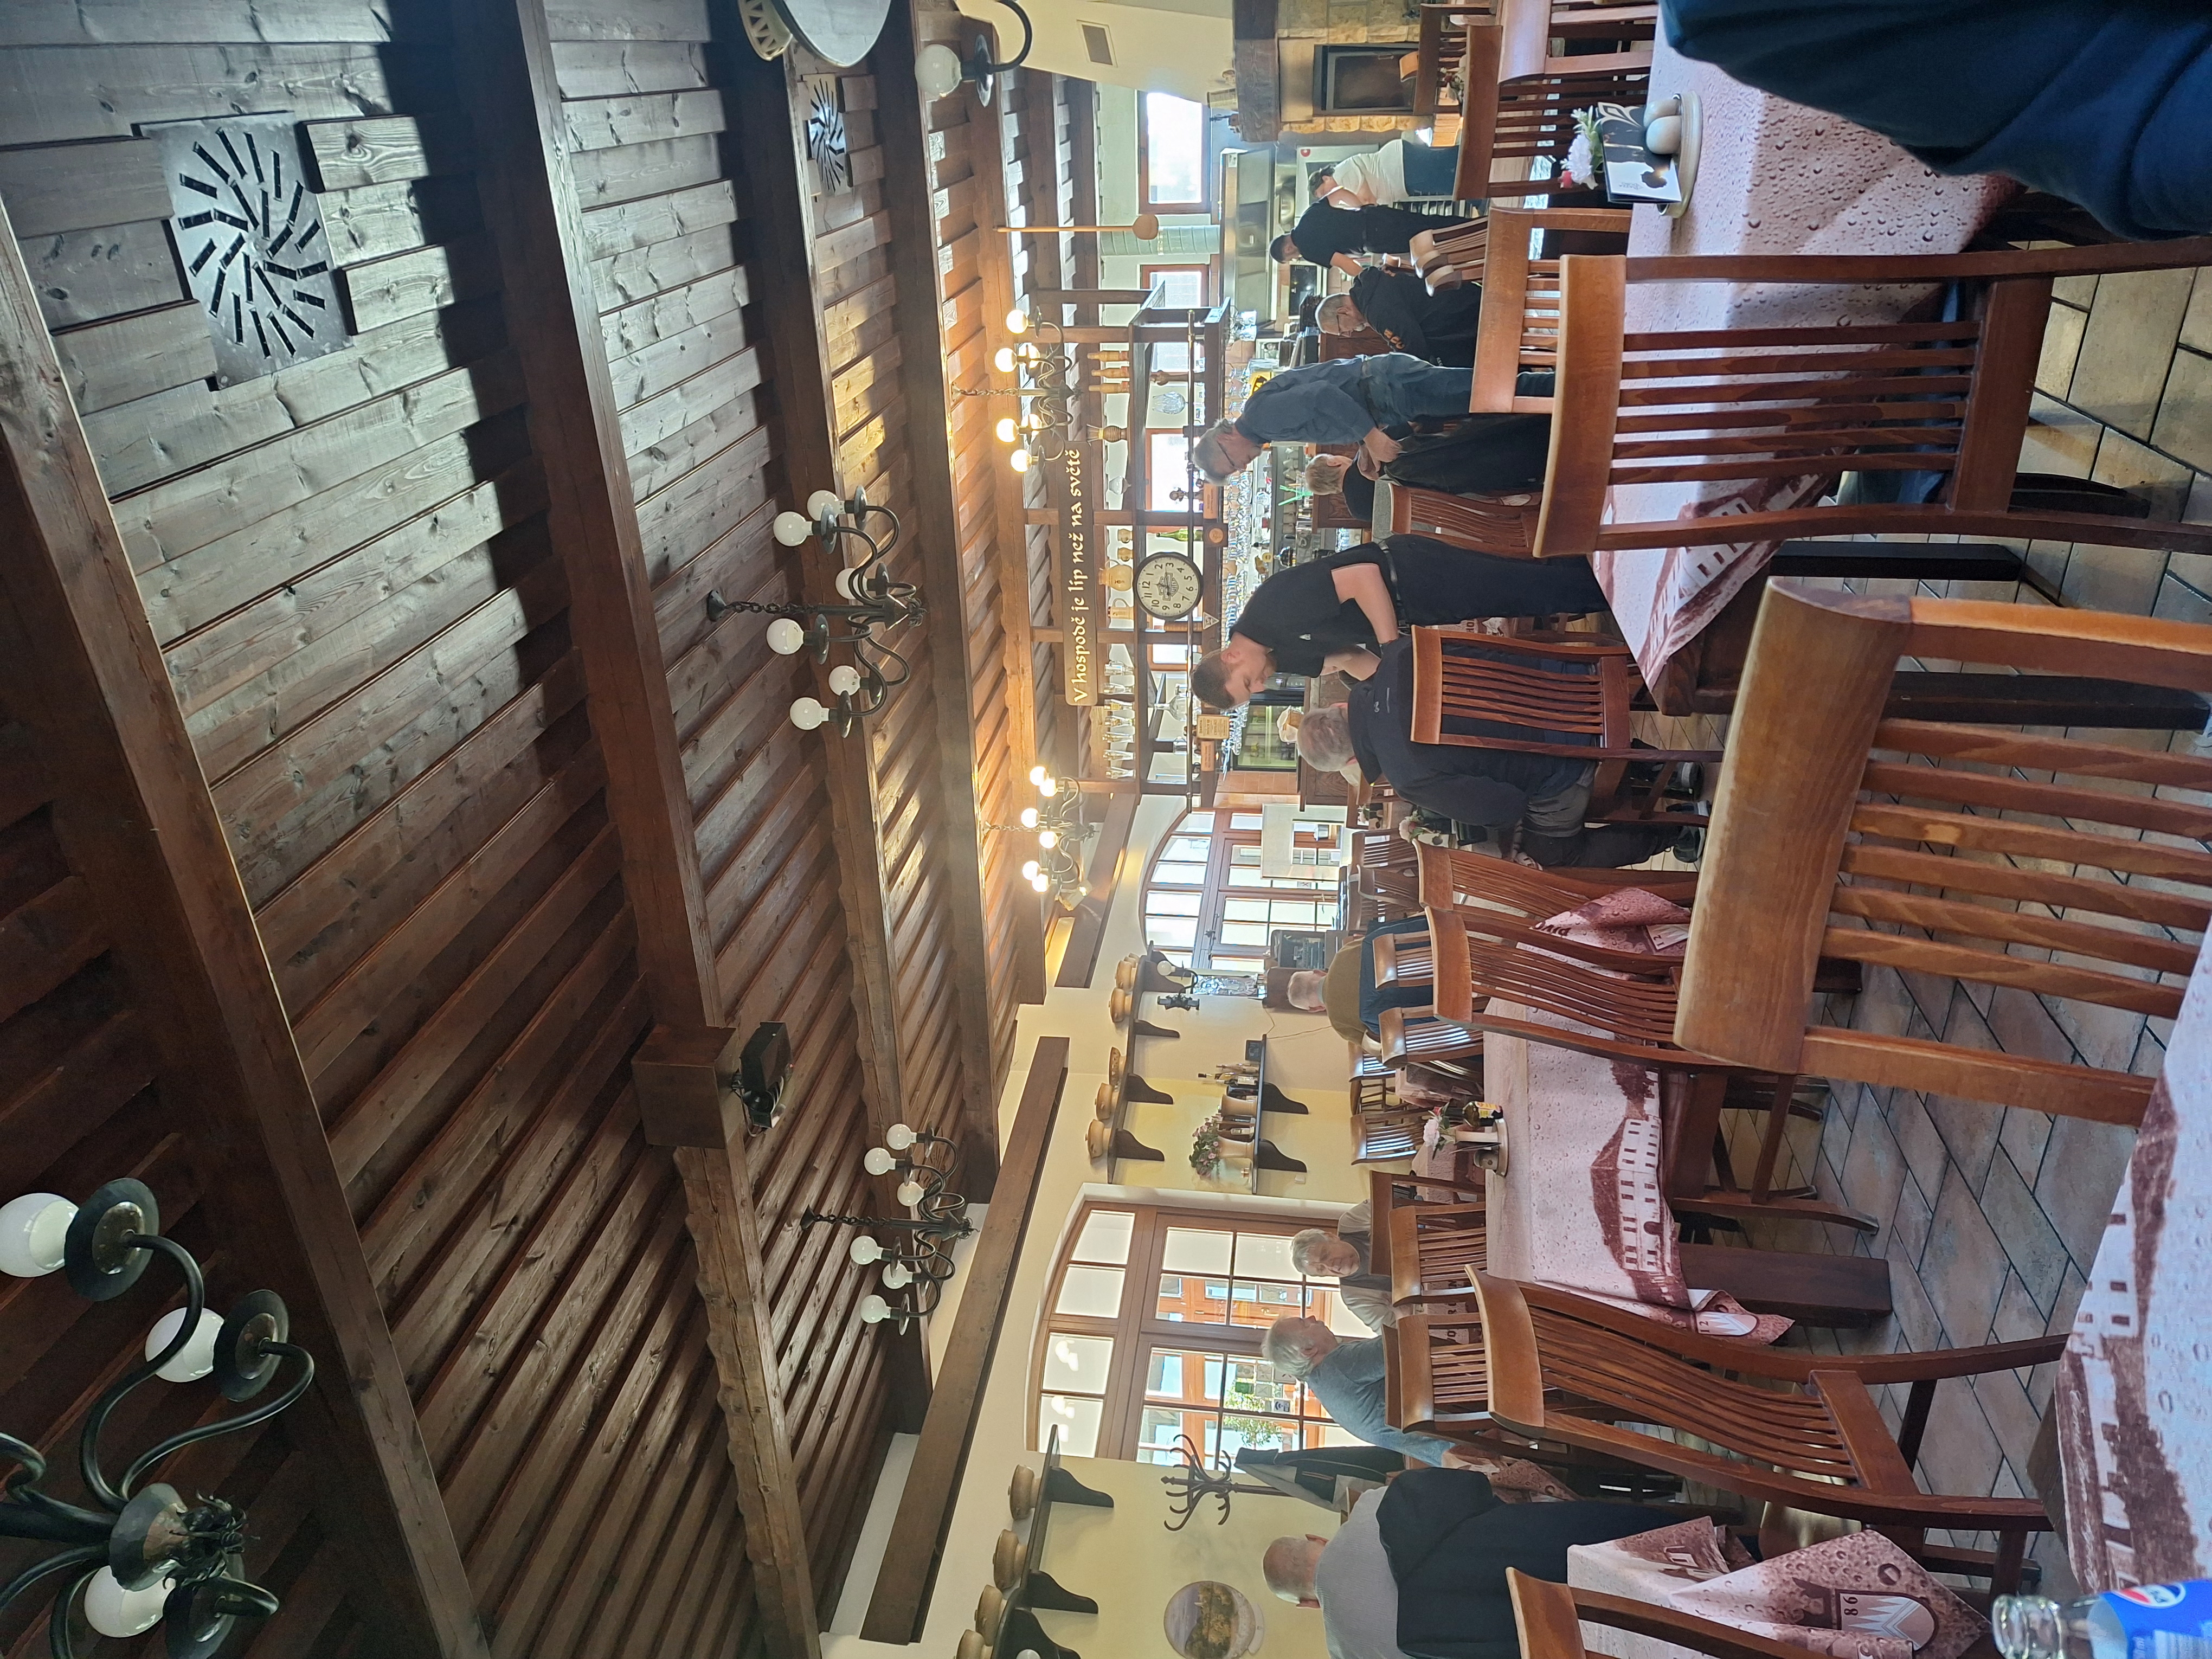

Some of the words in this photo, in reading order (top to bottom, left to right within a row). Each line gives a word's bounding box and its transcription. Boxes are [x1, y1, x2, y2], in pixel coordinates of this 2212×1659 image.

[1064, 449, 1082, 497] světě
[1071, 501, 1082, 527] na
[1068, 532, 1084, 564] než
[1068, 569, 1088, 592] líp
[1071, 597, 1089, 612] je
[1071, 616, 1090, 684] hospodě
[1073, 687, 1088, 703] V
[1653, 935, 1665, 947] 12
[1699, 1320, 1710, 1333] 12
[1843, 1596, 1859, 1616] 86
